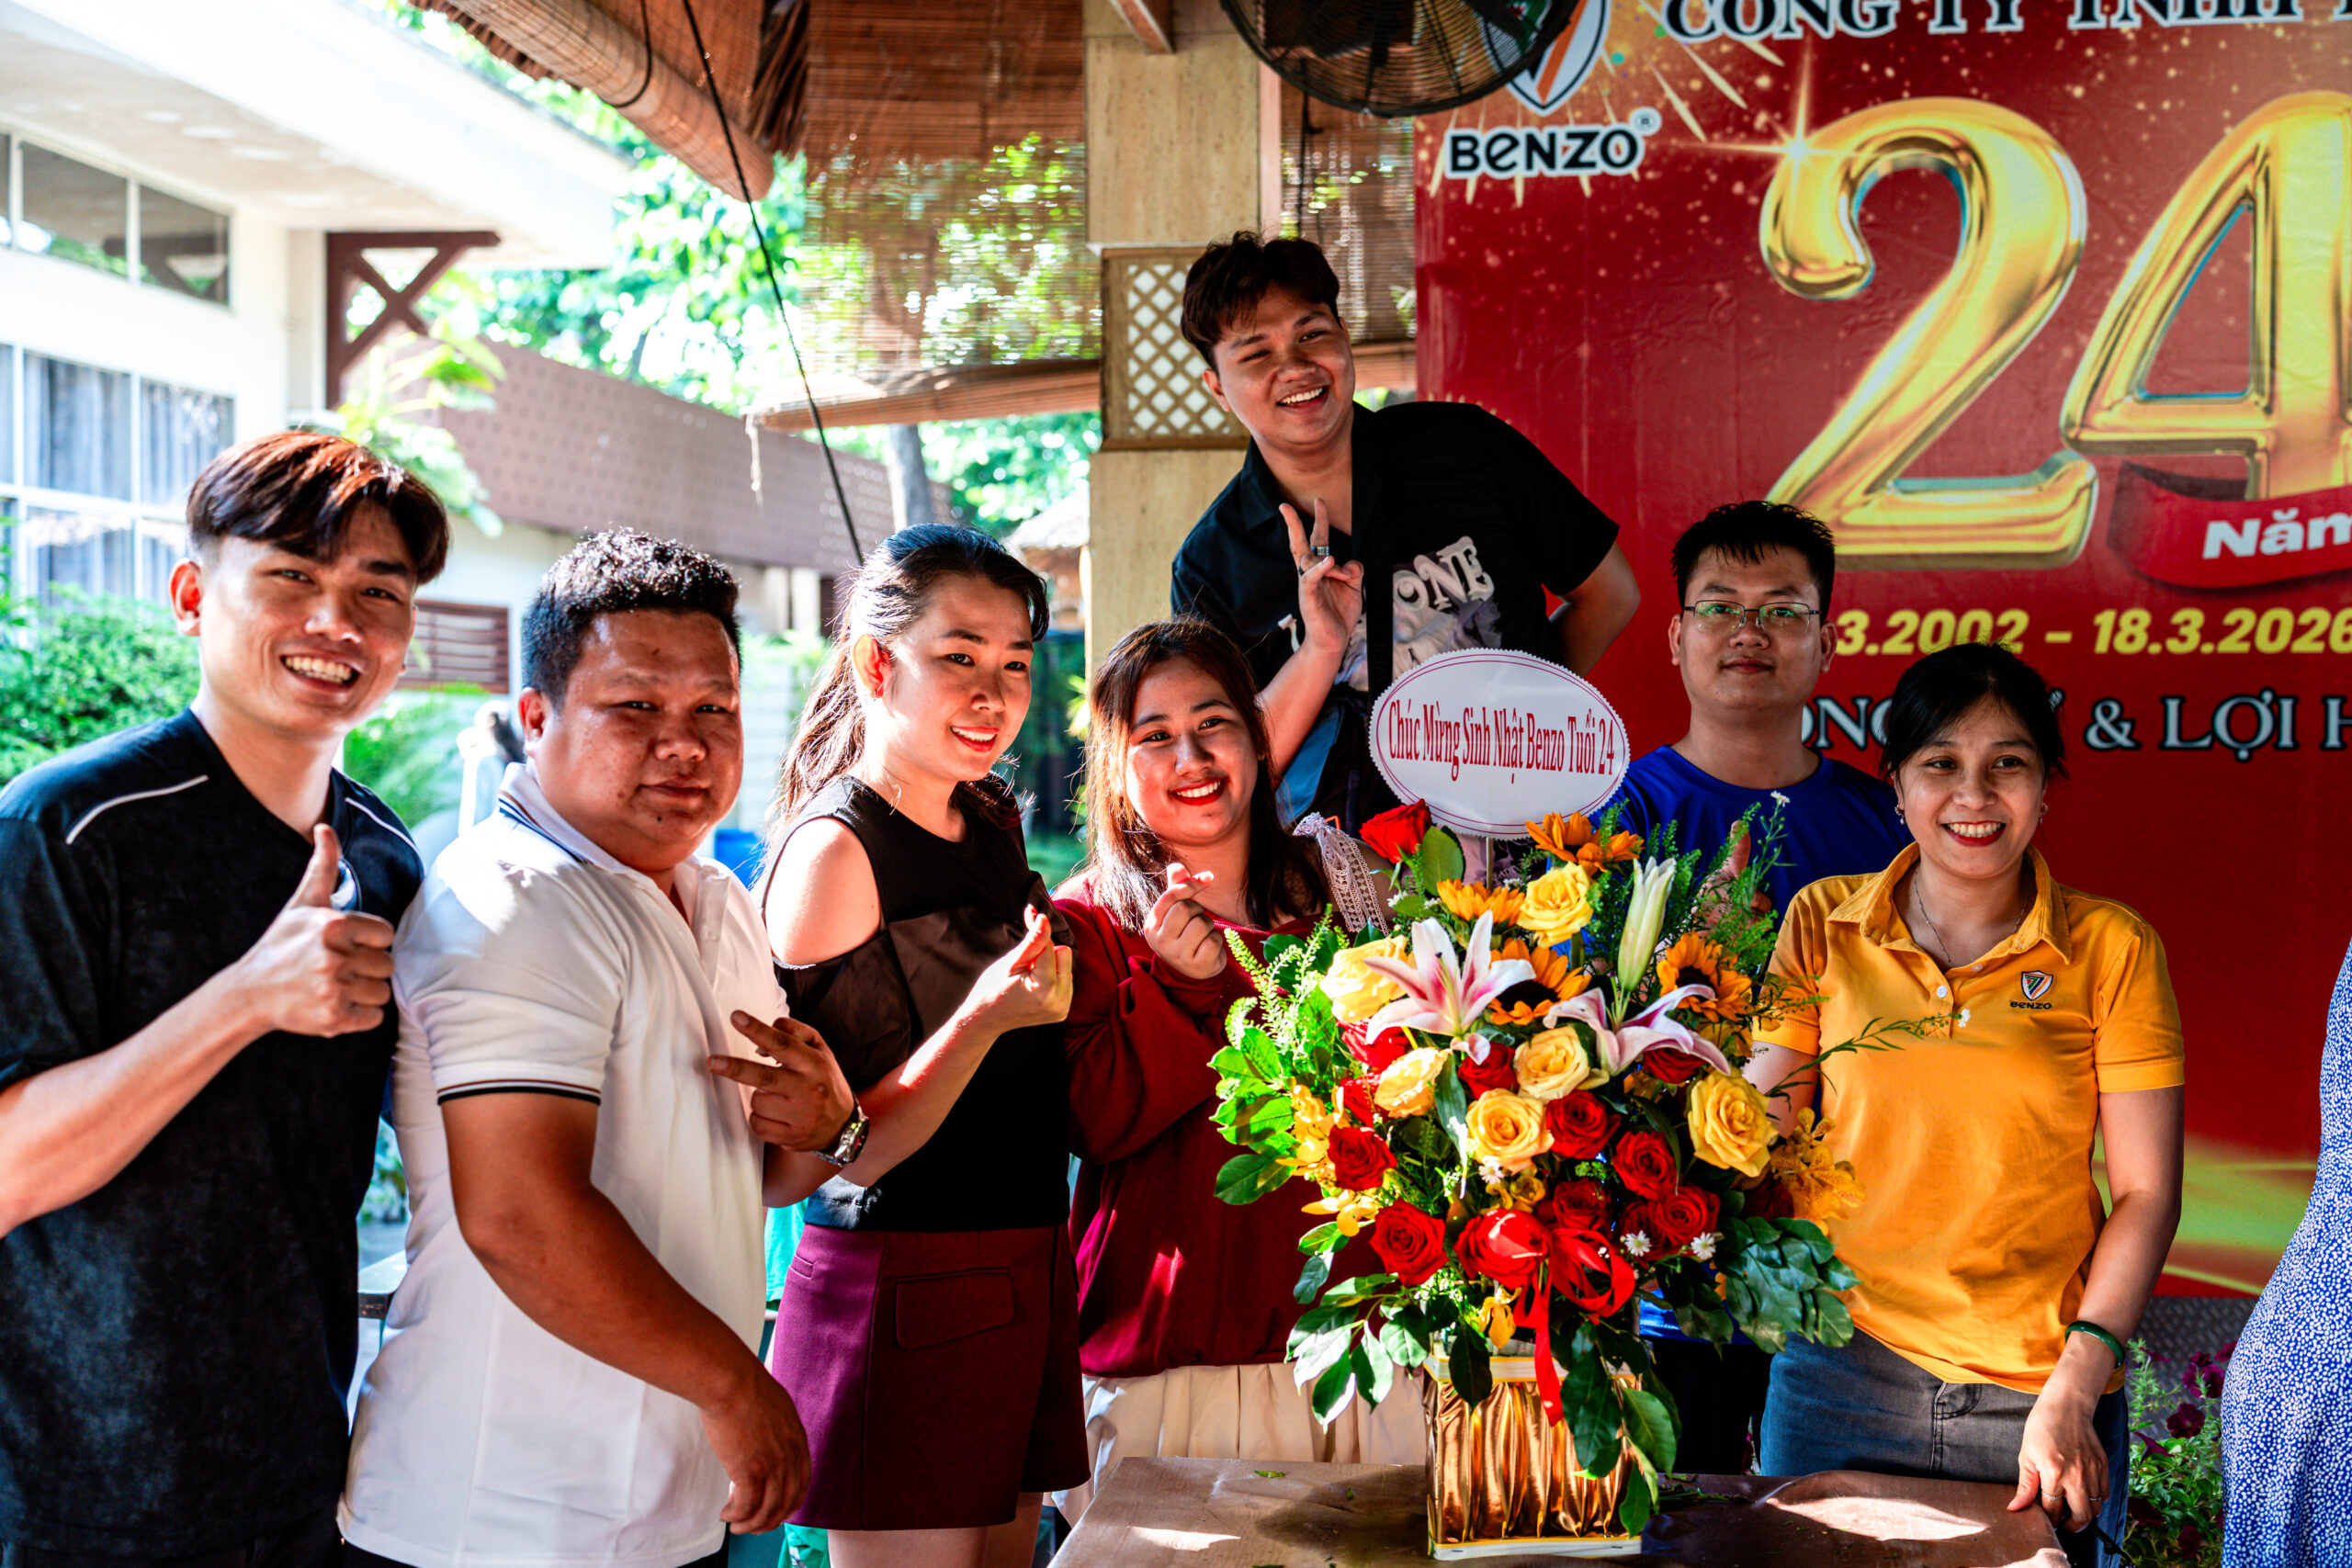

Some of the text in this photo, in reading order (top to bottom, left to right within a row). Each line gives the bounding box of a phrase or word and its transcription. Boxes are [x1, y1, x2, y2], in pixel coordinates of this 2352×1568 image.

[1758, 91, 2352, 571] 24
[2202, 507, 2352, 559] Năm
[2093, 606, 2352, 655] 18.3.2026
[1388, 698, 1615, 784] Chúc Mừng Sinh Nhật Benzo Tuổi 24
[2084, 698, 2139, 750] &
[2161, 689, 2296, 760] LỢI
